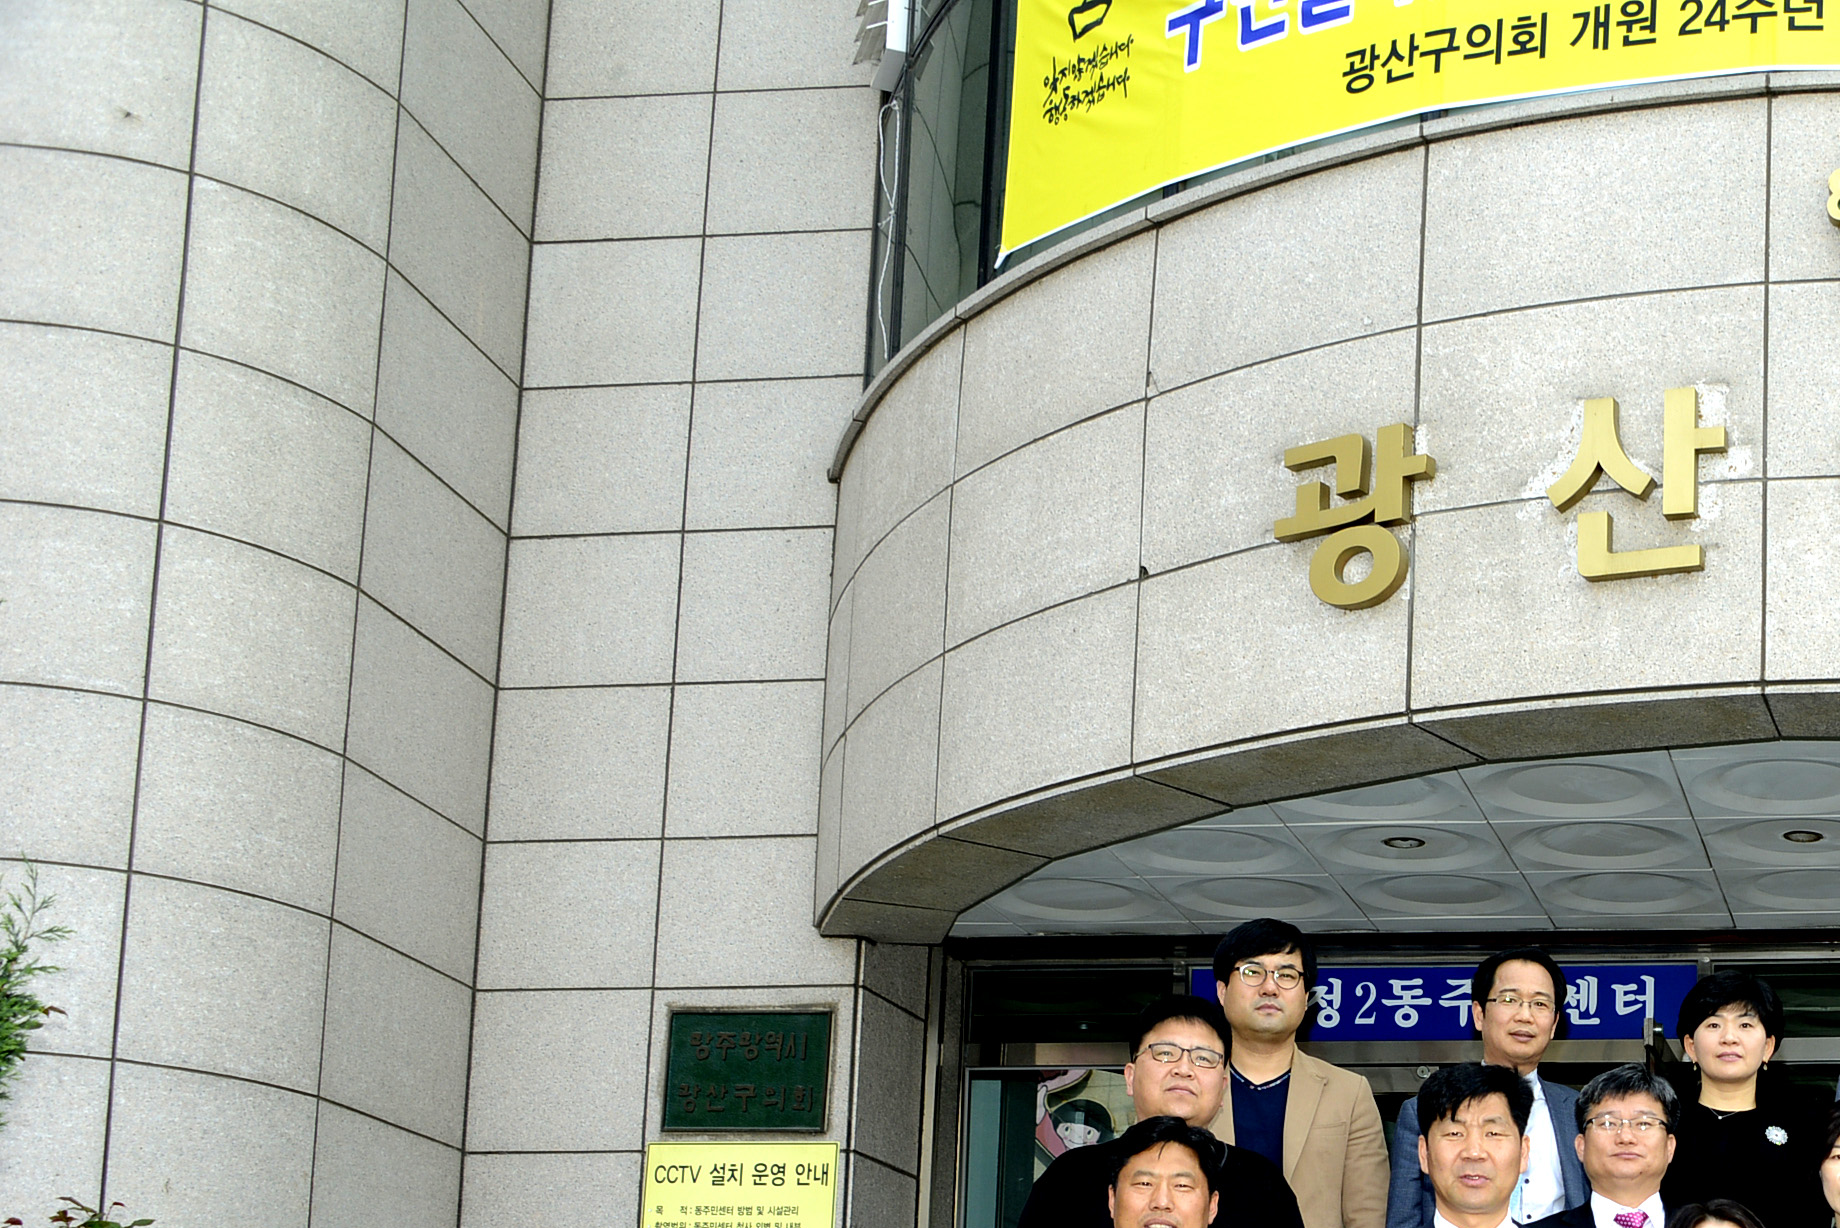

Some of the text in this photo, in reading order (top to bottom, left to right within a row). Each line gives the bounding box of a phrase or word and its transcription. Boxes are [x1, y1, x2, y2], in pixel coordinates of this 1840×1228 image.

[1342, 12, 1548, 94] 광산구의회
[1570, 0, 1657, 50] 개원
[1678, 0, 1824, 36] 24주년
[689, 1031, 808, 1061] 광주광역시
[678, 1082, 814, 1114] 광산구의회
[654, 1162, 830, 1187] CCTV 설치 운영 안내
[694, 1205, 734, 1216] 동주민센터
[737, 1205, 753, 1216] 방범
[767, 1205, 799, 1216] 시설관리
